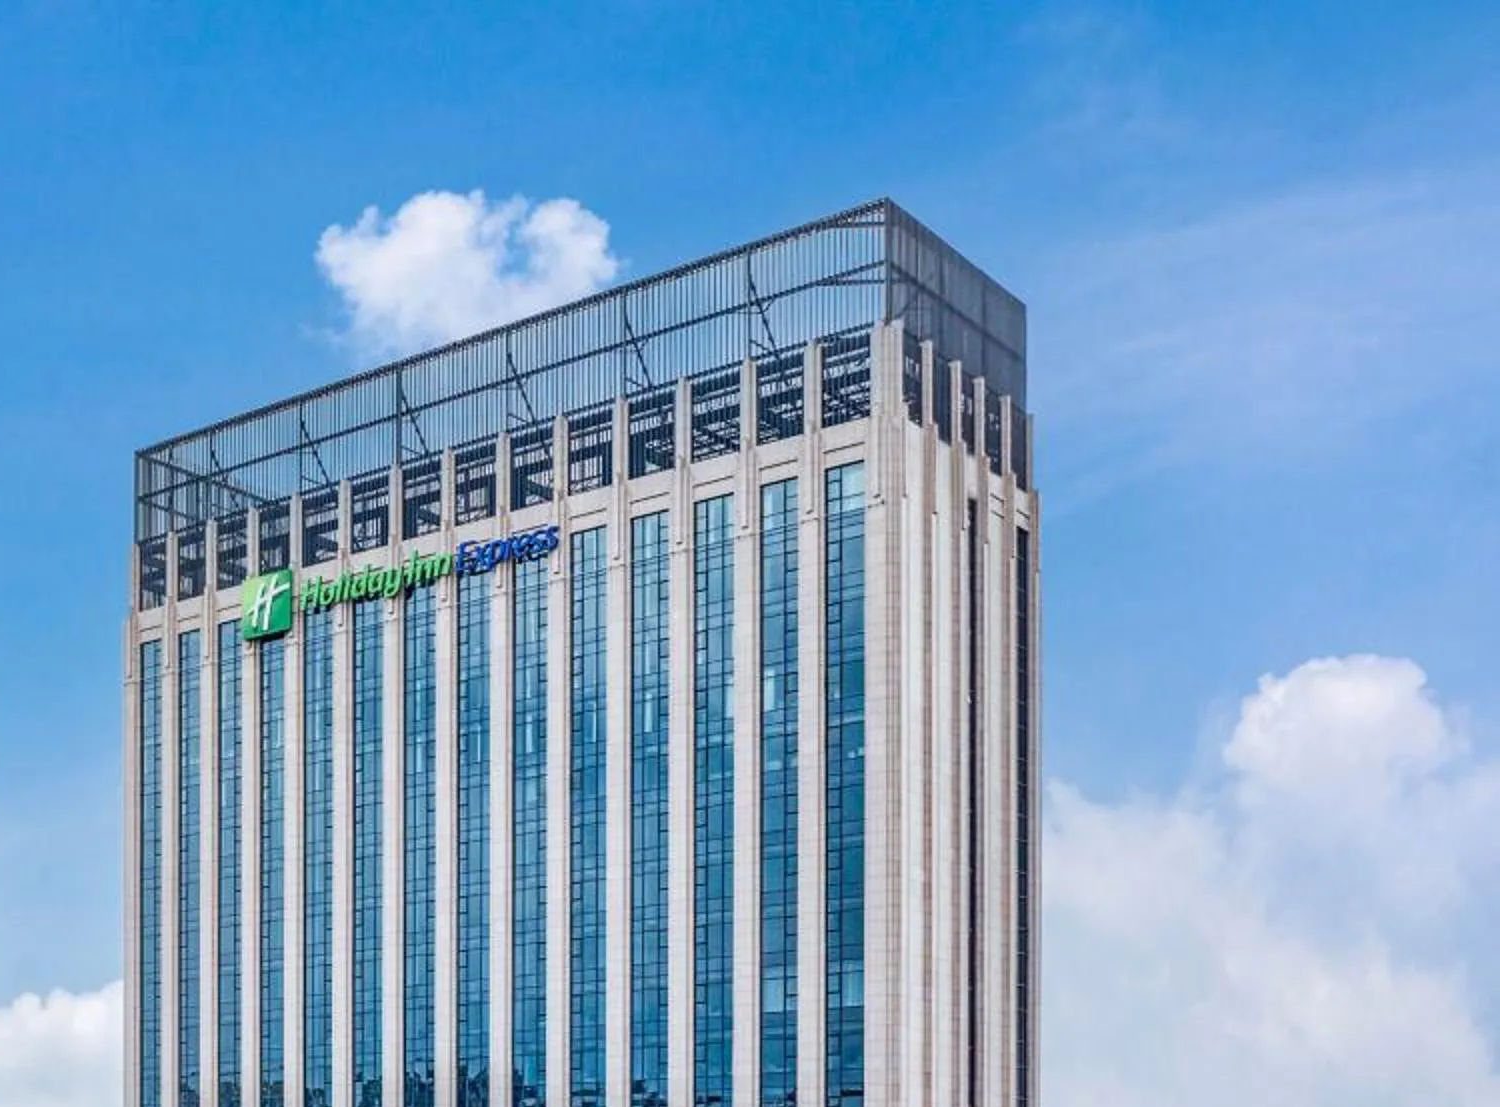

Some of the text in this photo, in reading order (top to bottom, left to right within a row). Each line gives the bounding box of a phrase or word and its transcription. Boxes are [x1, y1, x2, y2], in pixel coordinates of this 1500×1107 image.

[300, 526, 559, 610] Holiday Inn Express
